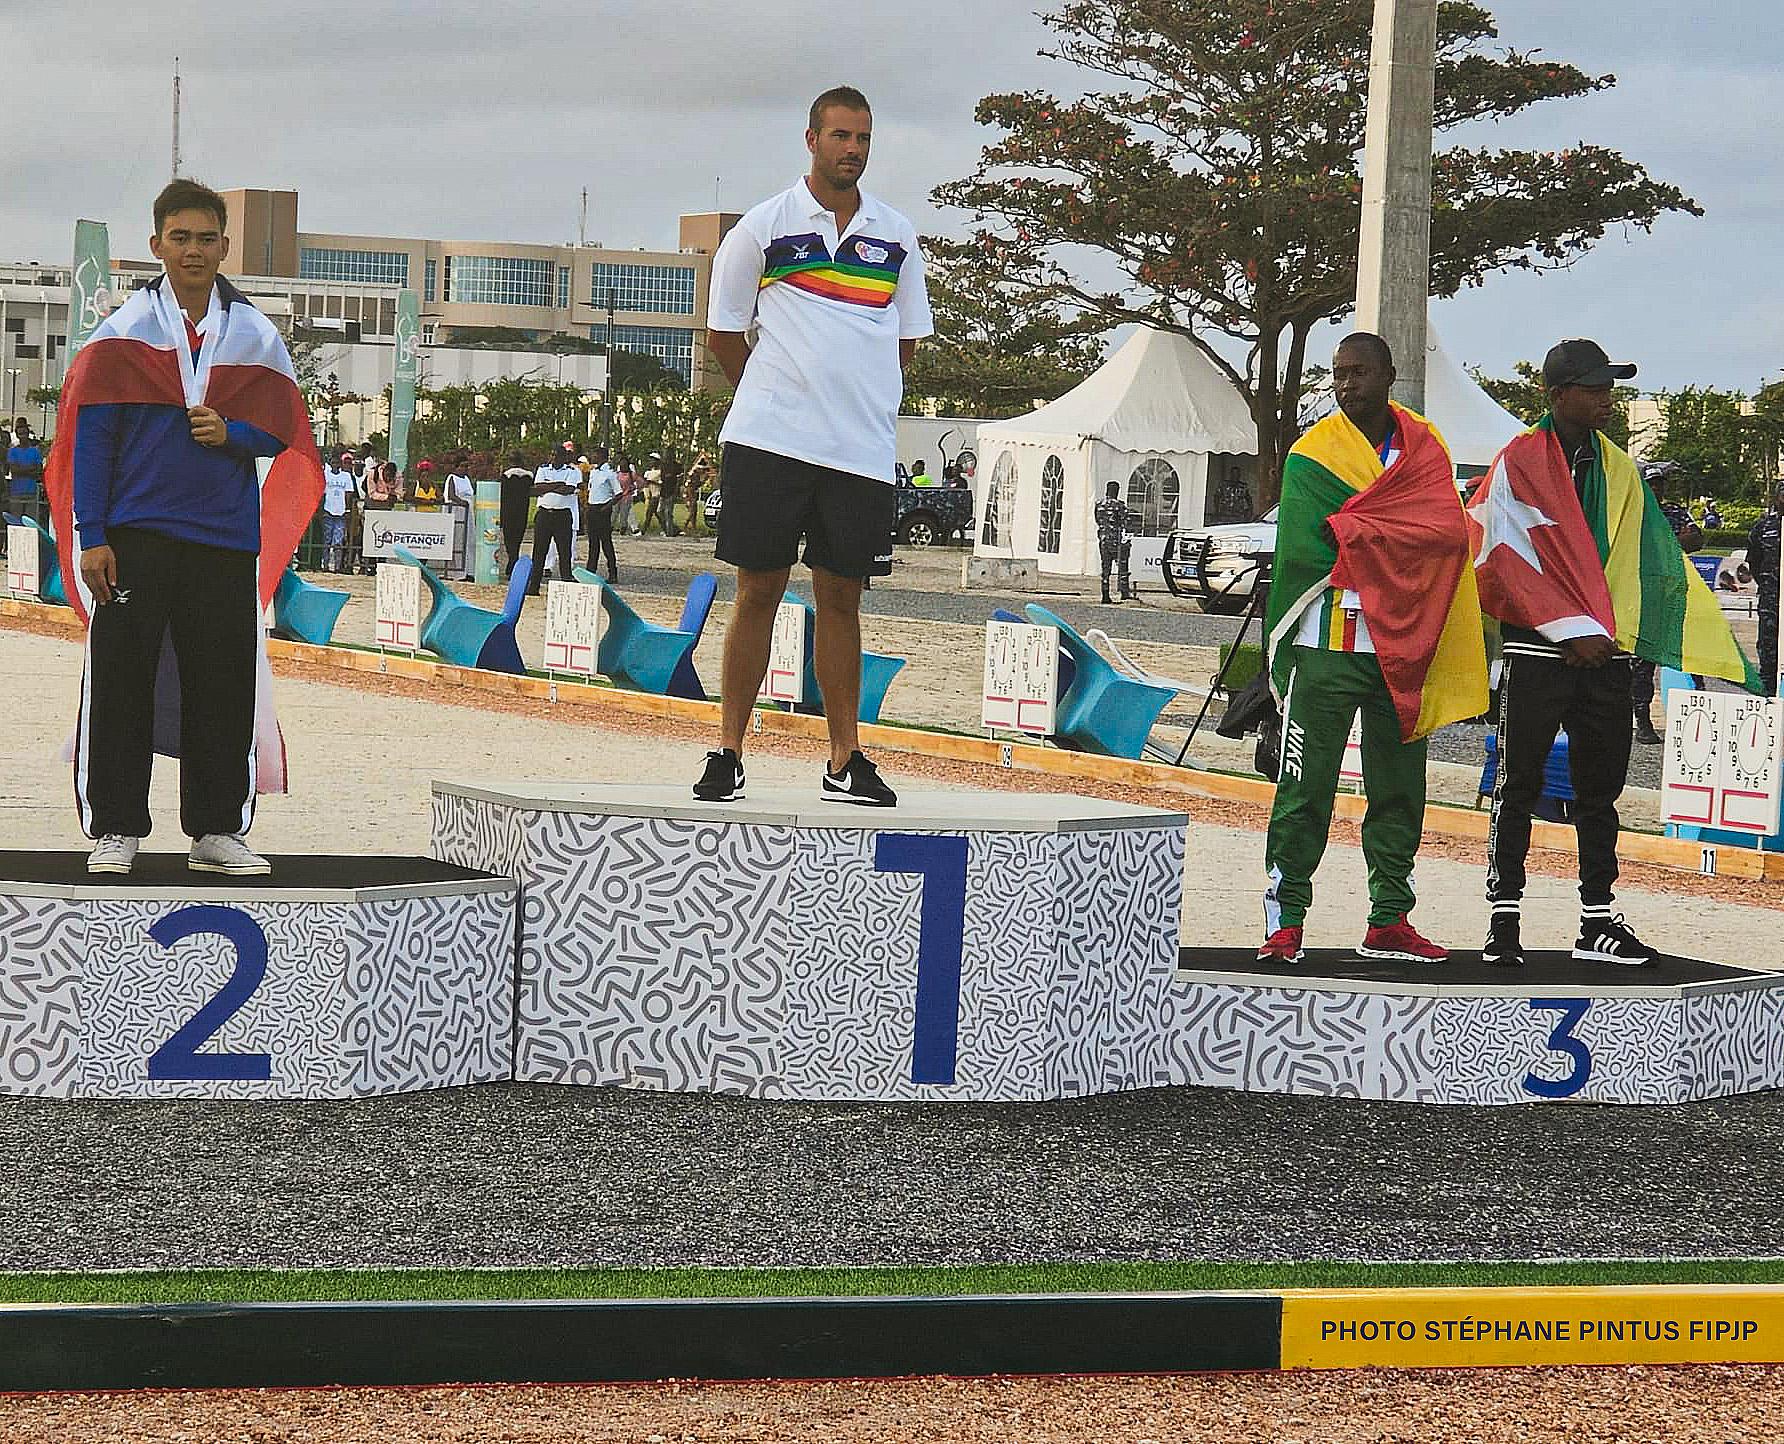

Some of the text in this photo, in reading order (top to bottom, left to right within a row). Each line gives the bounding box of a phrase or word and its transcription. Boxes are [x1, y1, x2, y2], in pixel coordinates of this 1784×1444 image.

[1690, 696, 1698, 707] 13
[1700, 696, 1704, 707] 0
[1708, 698, 1712, 710] 1
[1746, 700, 1753, 711] 13
[1756, 700, 1760, 712] 0
[1681, 704, 1688, 716] 12
[1736, 709, 1744, 720] 12
[1712, 712, 1716, 723] 2
[1768, 716, 1773, 728] 2
[1676, 720, 1682, 731] 11
[1731, 725, 1737, 736] 11
[1712, 730, 1718, 742] 3
[1769, 736, 1774, 747] 3
[1673, 736, 1681, 748] 10
[1728, 741, 1737, 752] 10
[1286, 719, 1305, 782] NIKE
[1676, 750, 1682, 762] 9
[1732, 755, 1737, 766] 9
[1706, 764, 1712, 775] 5
[1763, 769, 1768, 780] 5
[1688, 772, 1694, 782] 7
[1698, 772, 1702, 782] 6
[1744, 777, 1749, 788] 7
[1754, 777, 1759, 788] 6
[1702, 850, 1715, 873] 11
[875, 833, 969, 1083] 1
[147, 905, 271, 1080] 2
[1522, 998, 1591, 1098] 3
